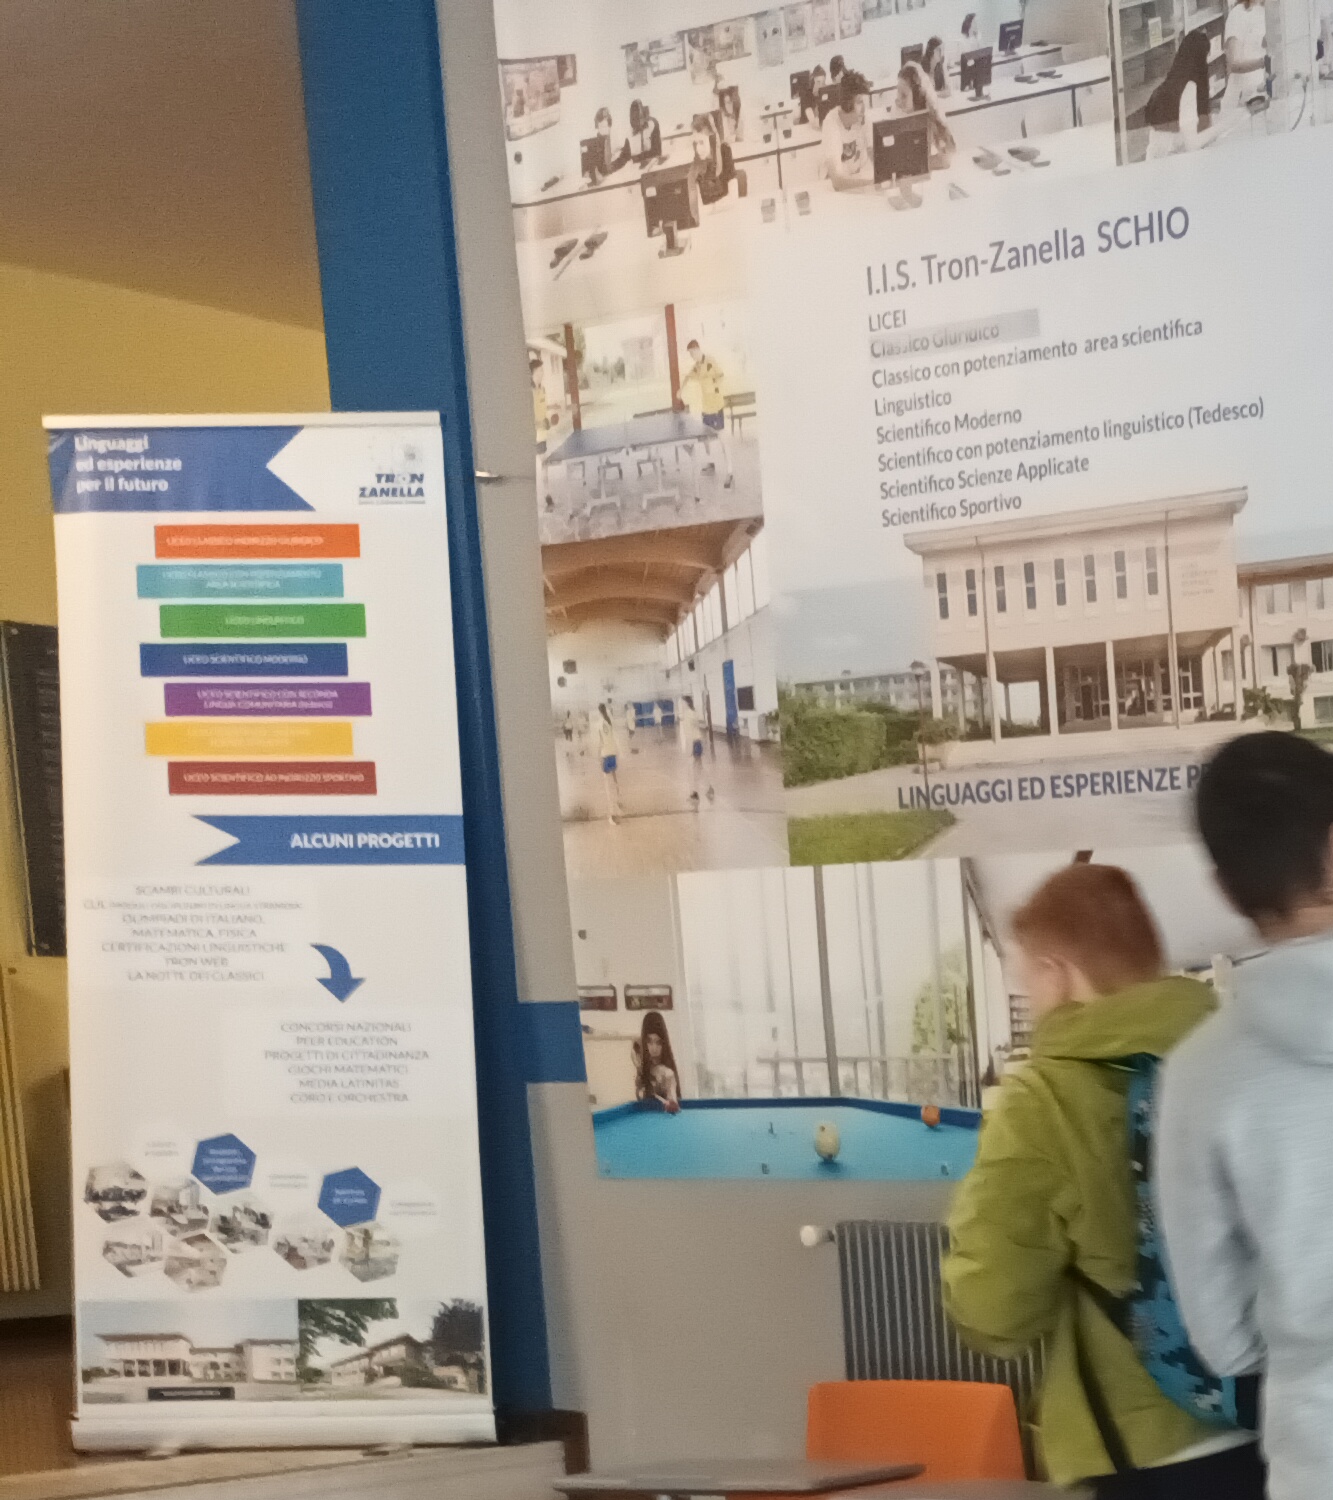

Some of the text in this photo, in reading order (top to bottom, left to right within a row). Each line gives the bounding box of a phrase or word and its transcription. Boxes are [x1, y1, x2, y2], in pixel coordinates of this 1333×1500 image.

[867, 206, 1190, 295] I.I.S. Tron-Zanella SCHIO
[869, 310, 906, 332] LICEI
[872, 318, 1203, 389] Classico con potenziamento area scientifica
[875, 389, 952, 417] Linguistico
[876, 406, 1022, 444] Scientifico Moderno
[878, 397, 1265, 472] Scientifico con potenziamento linguistico (Tedesco)
[74, 435, 148, 453] Linguaggi
[76, 458, 182, 473] ed esperienze
[880, 454, 1089, 499] Scientifico Scienze Applicate
[77, 477, 168, 494] per il futuro
[358, 487, 425, 497] ZANELLA
[882, 494, 1022, 527] Scientifico Sportivo
[898, 777, 1013, 810] LINGUAGGI
[1018, 777, 1045, 801] ED
[1051, 766, 1181, 798] ESPERIENZE
[290, 833, 439, 848] ALCUNI PROGETTI
